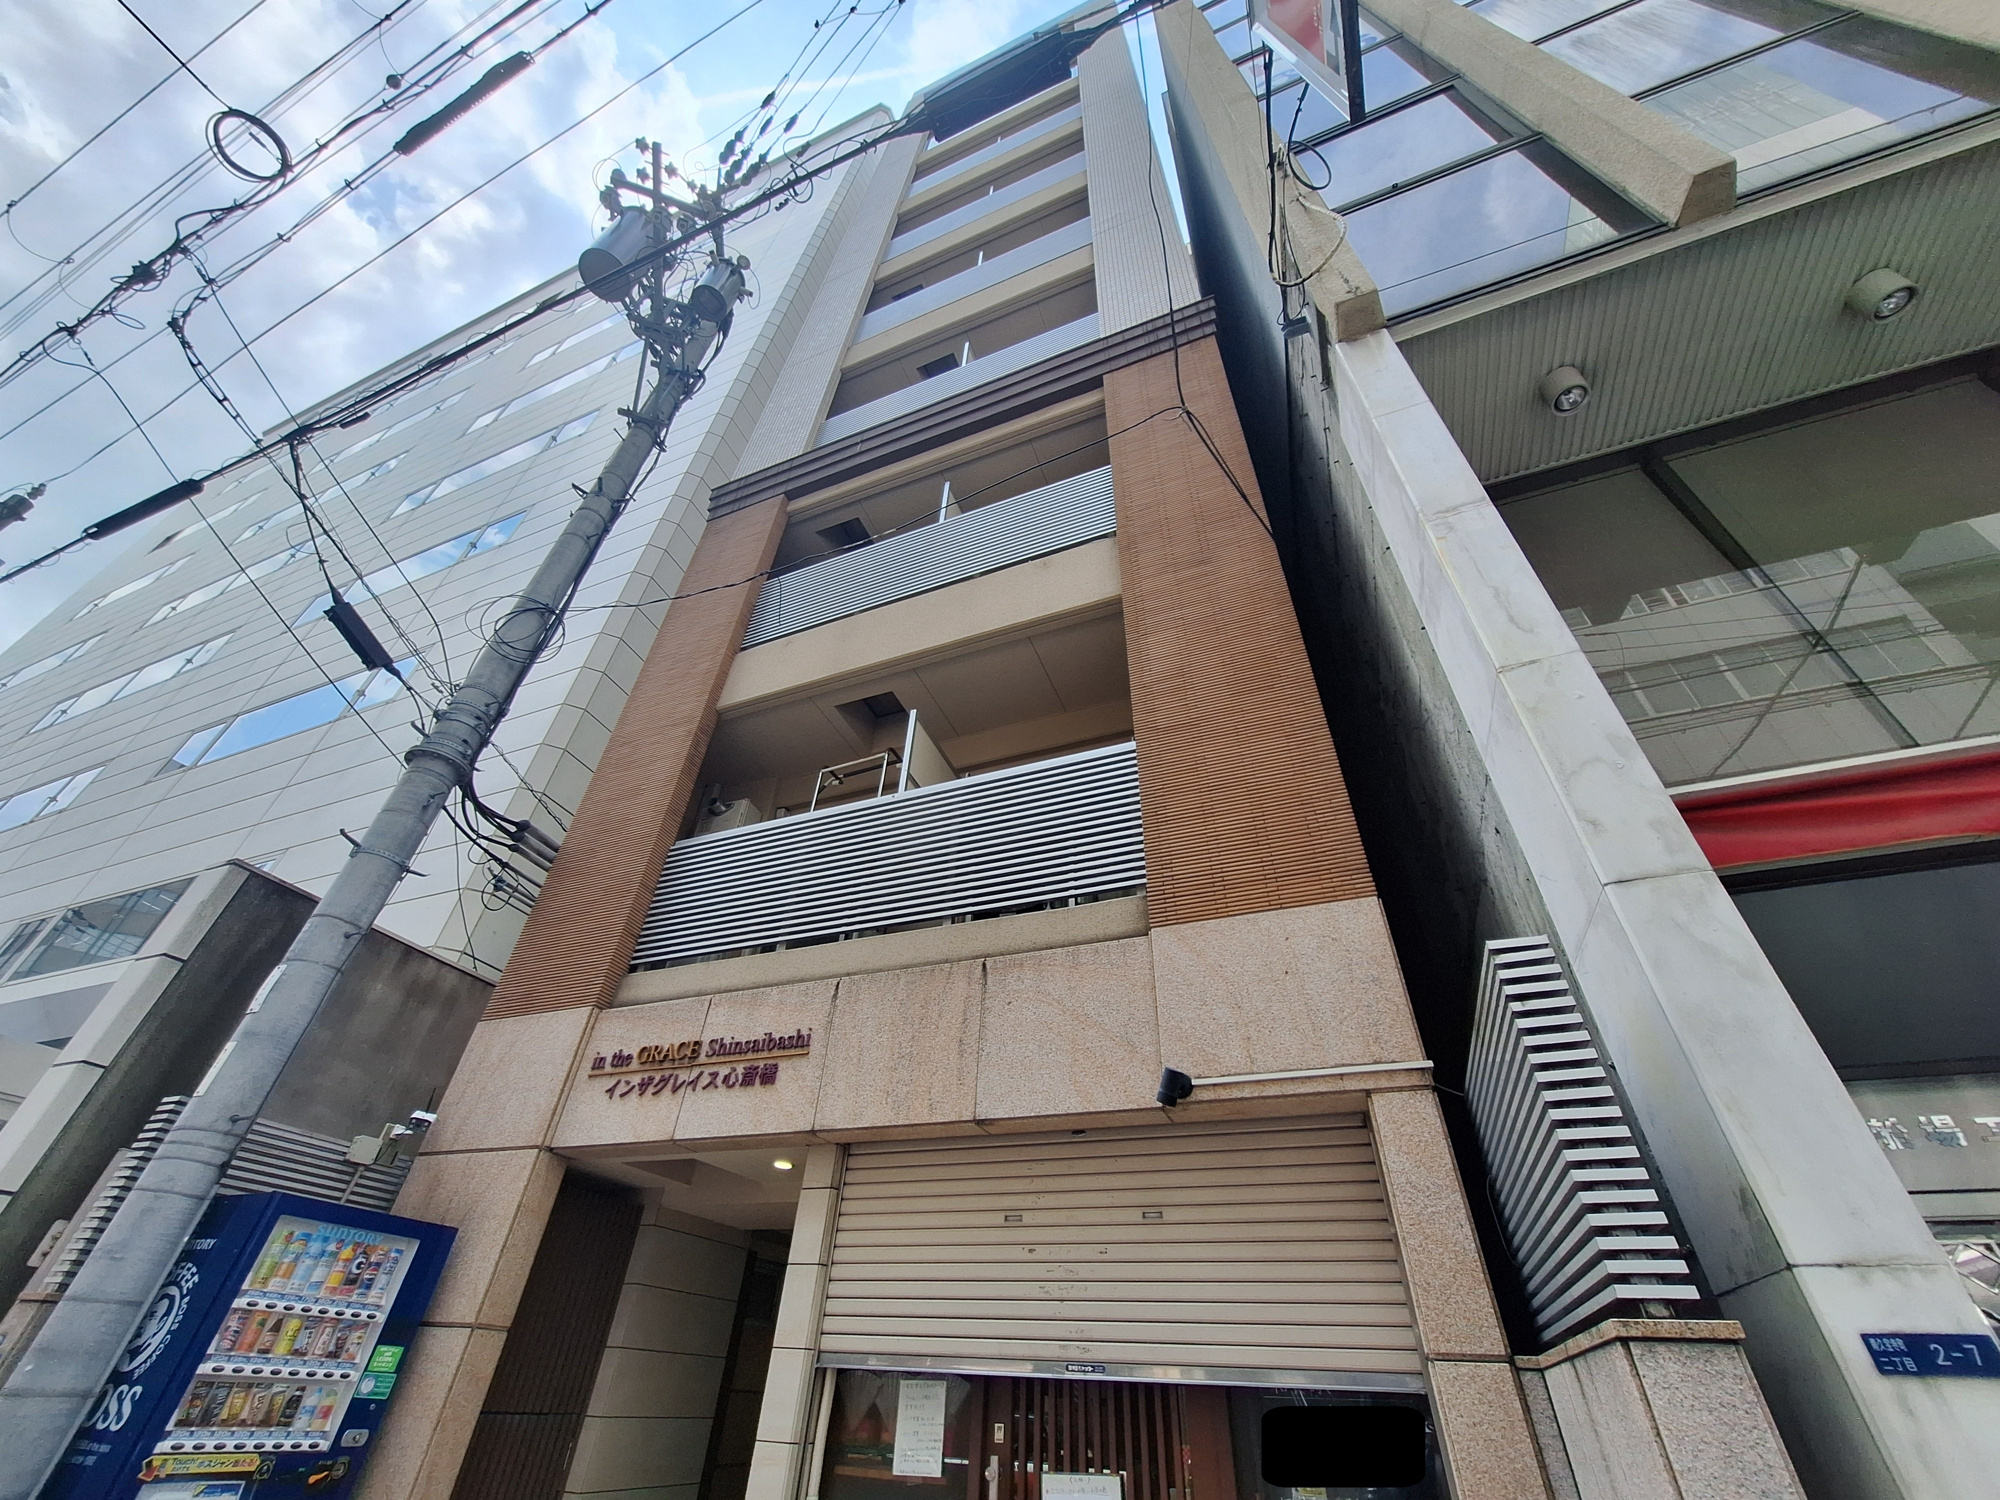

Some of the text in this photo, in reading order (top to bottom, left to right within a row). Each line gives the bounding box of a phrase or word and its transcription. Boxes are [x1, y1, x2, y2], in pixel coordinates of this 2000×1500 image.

[591, 1028, 812, 1070] in the GRACE Shinsaibashi
[605, 1063, 779, 1099] インザグレイス心斎橋
[1880, 1357, 1918, 1372] 二丁目
[1930, 1343, 1982, 1366] 2-7
[82, 1384, 142, 1431] OSS
